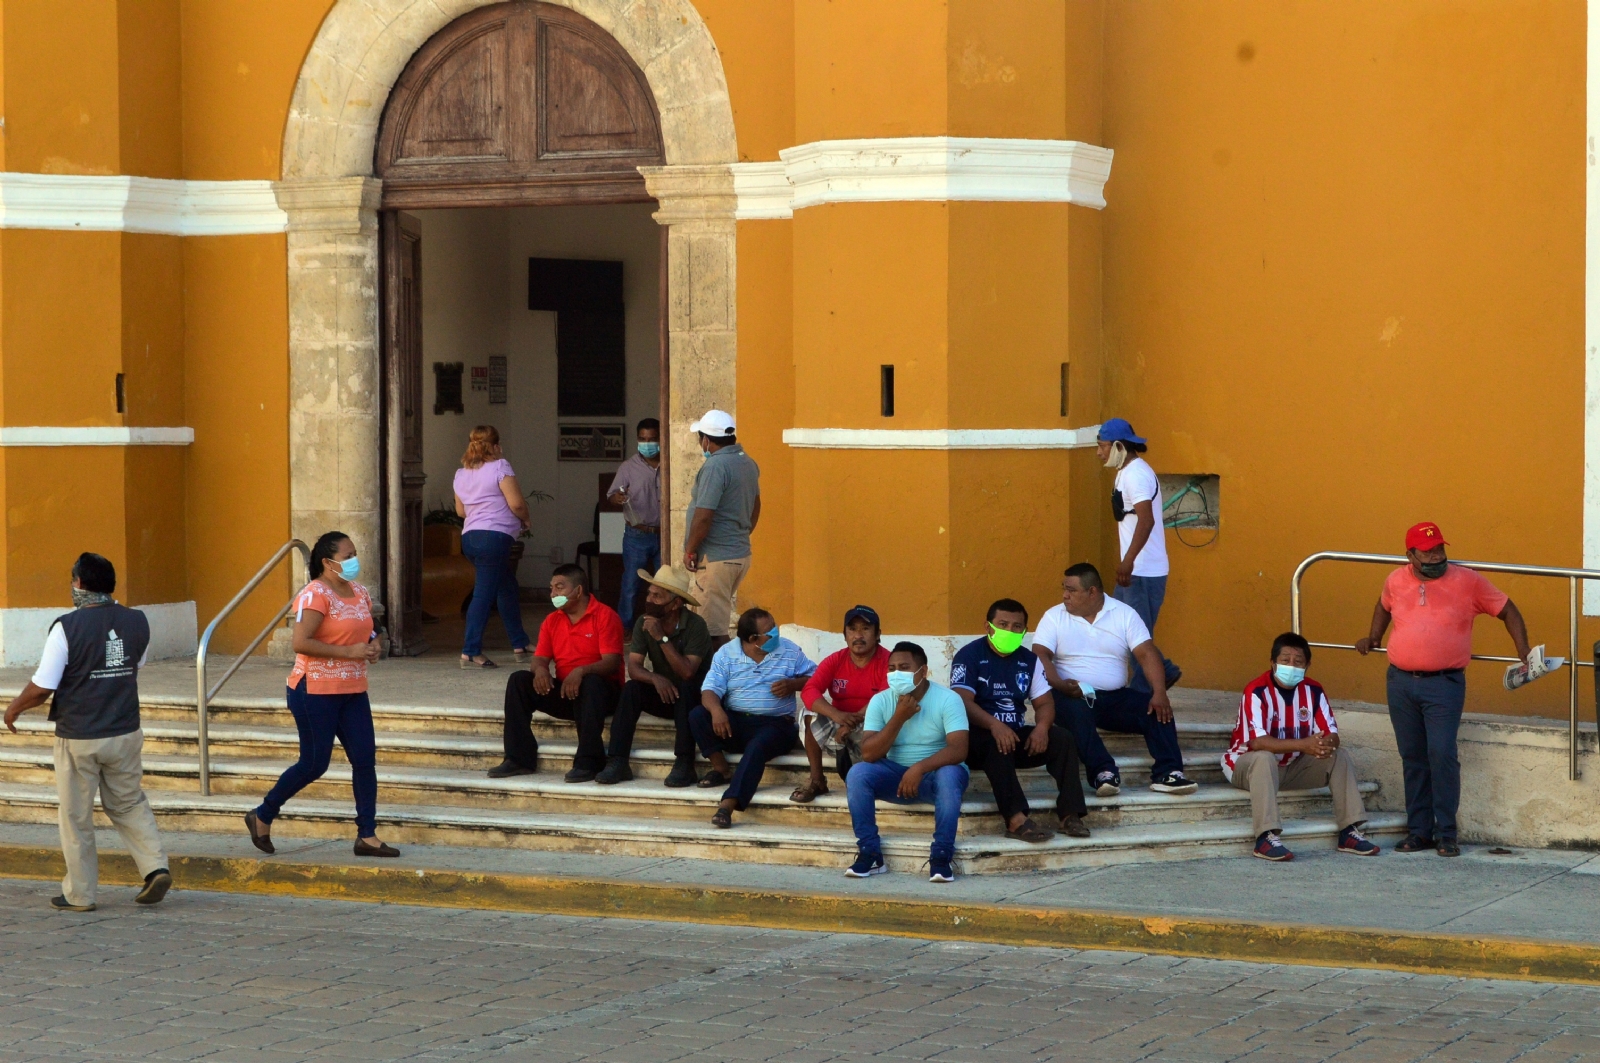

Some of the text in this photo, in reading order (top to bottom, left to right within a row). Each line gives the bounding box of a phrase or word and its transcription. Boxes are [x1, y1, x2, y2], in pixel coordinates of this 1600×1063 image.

[561, 437, 621, 448] CONCORDIA
[833, 679, 849, 688] NY
[993, 712, 1017, 722] AT&T
